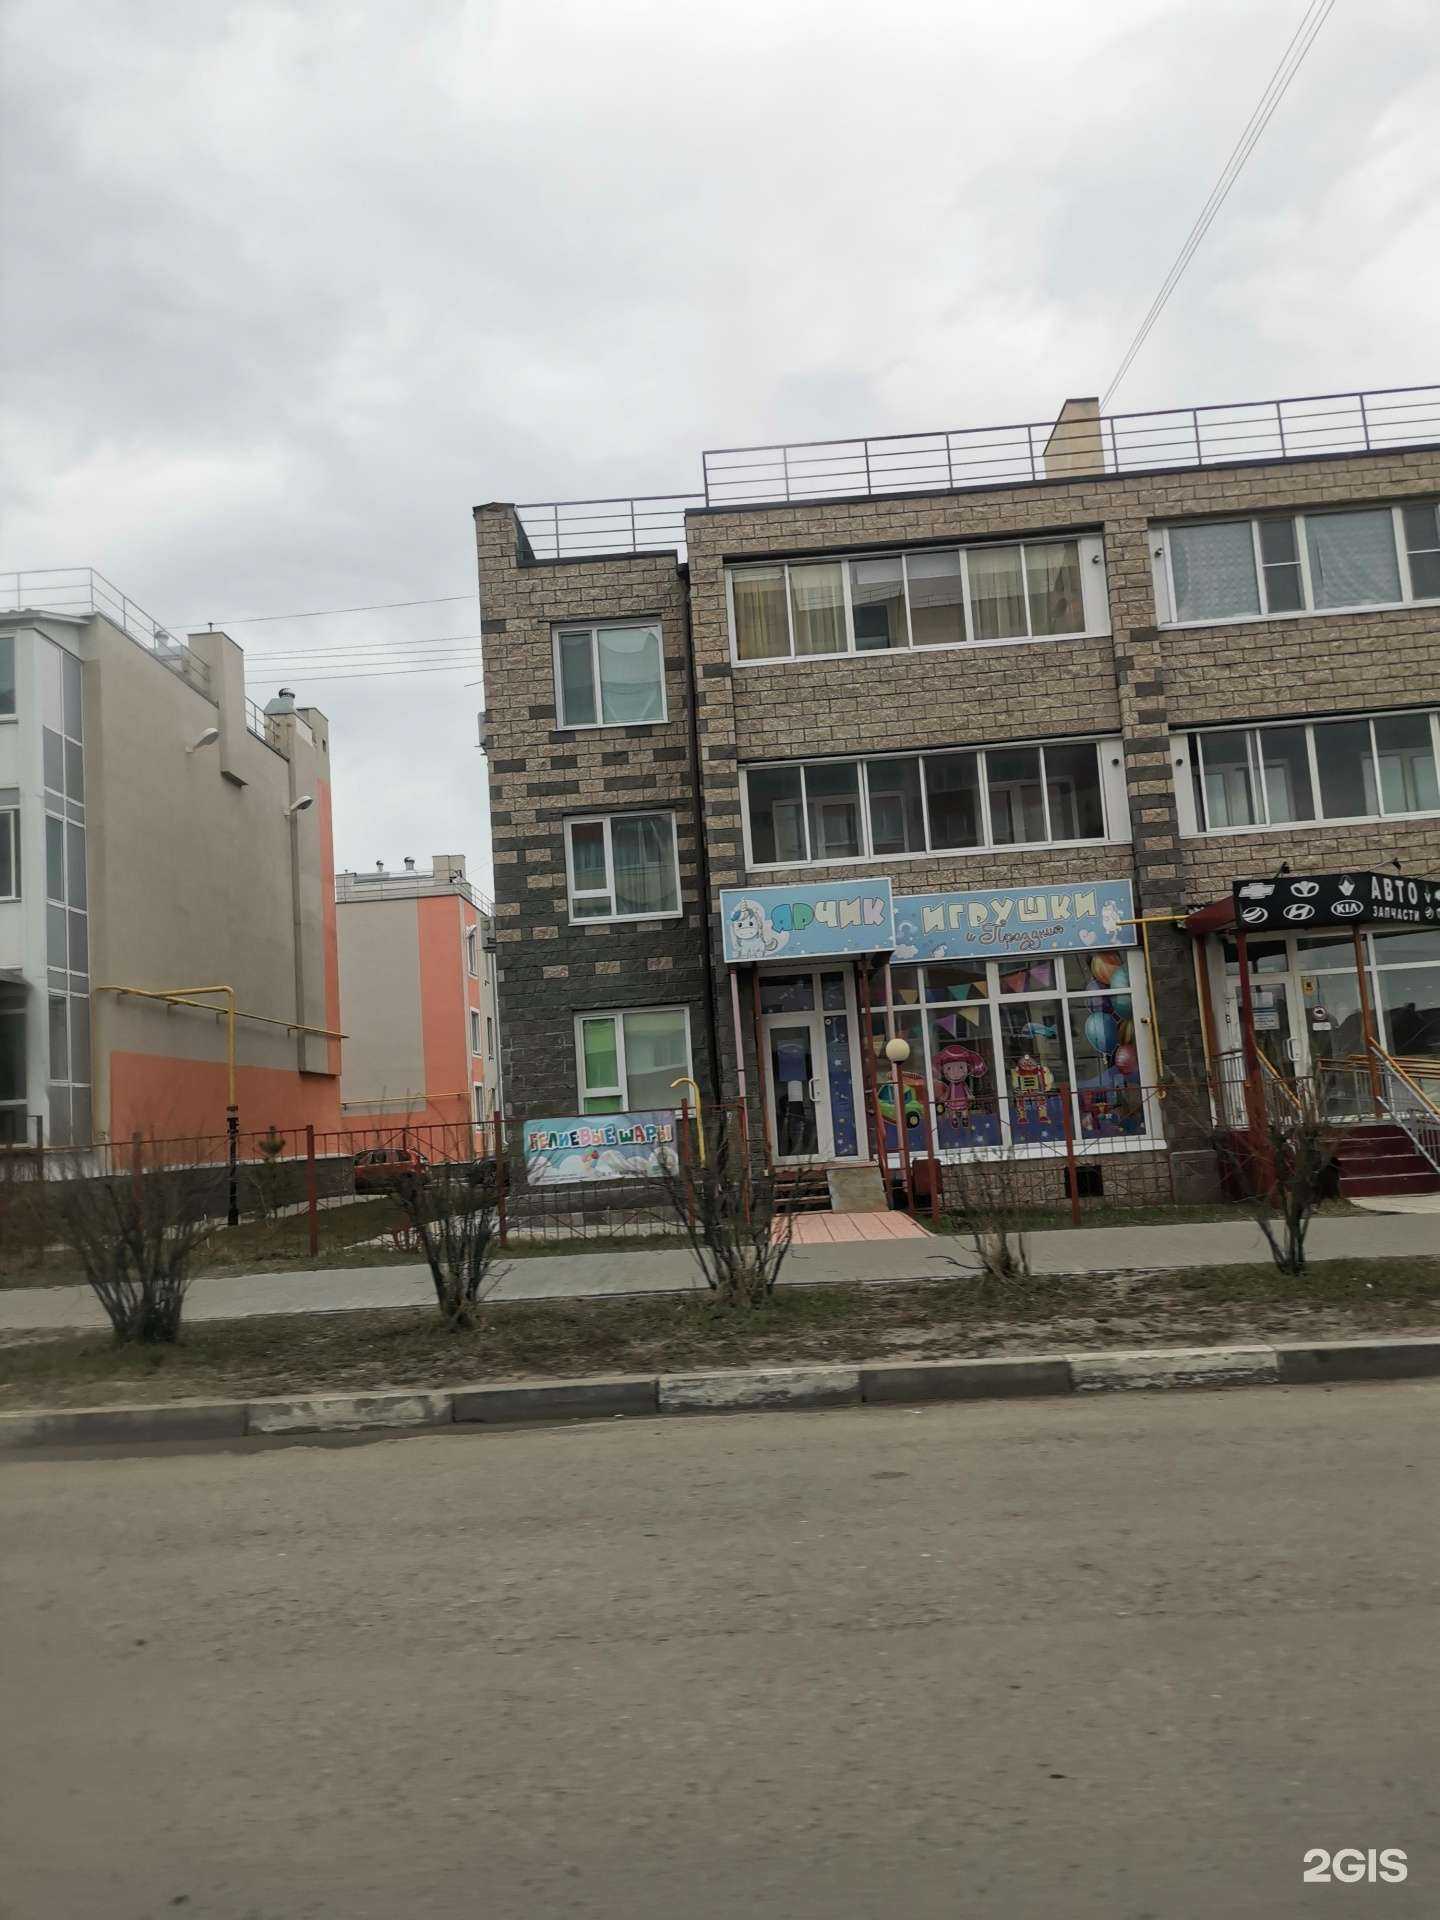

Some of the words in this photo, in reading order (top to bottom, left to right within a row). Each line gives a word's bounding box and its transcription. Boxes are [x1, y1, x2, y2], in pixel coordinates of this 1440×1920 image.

[1371, 876, 1419, 905] АВТО
[771, 896, 886, 933] ЯРЧИК
[922, 889, 1098, 935] ИГРУШКИ
[1337, 903, 1359, 914] KIA
[1372, 906, 1420, 922] ЗАПЧАСТИ
[528, 1125, 616, 1152] ГЕЛИЕВЫЕ
[618, 1124, 673, 1145] ШАРЫ
